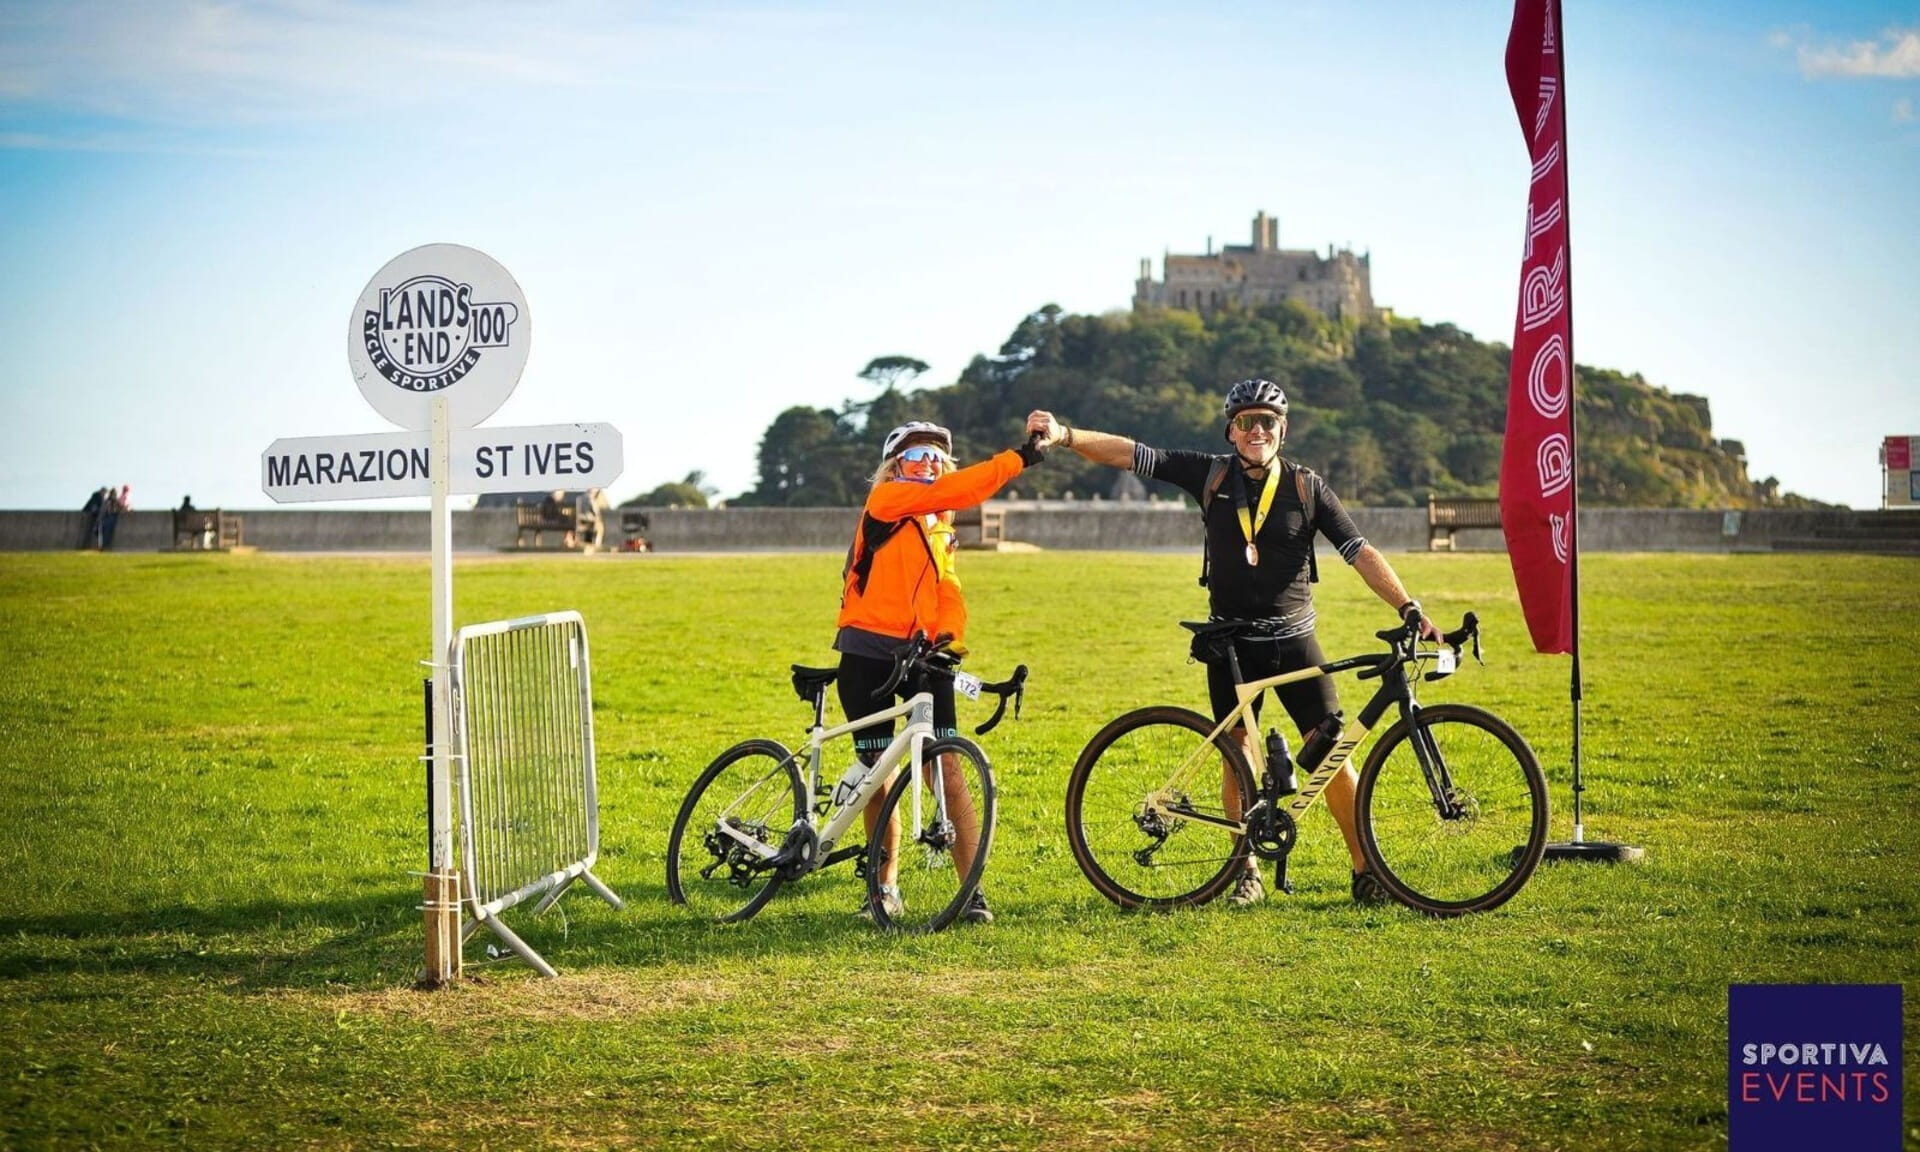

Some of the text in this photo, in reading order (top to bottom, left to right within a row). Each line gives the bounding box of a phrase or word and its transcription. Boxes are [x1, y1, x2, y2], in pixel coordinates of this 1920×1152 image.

[382, 286, 470, 330] LANDS
[472, 306, 506, 343] 100
[365, 314, 477, 391] CYCLE SPORTIVE
[404, 331, 451, 365] END
[267, 447, 430, 487] MARAZION
[475, 441, 595, 478] ST IVES
[959, 679, 977, 696] 172
[1291, 741, 1358, 810] CANYON
